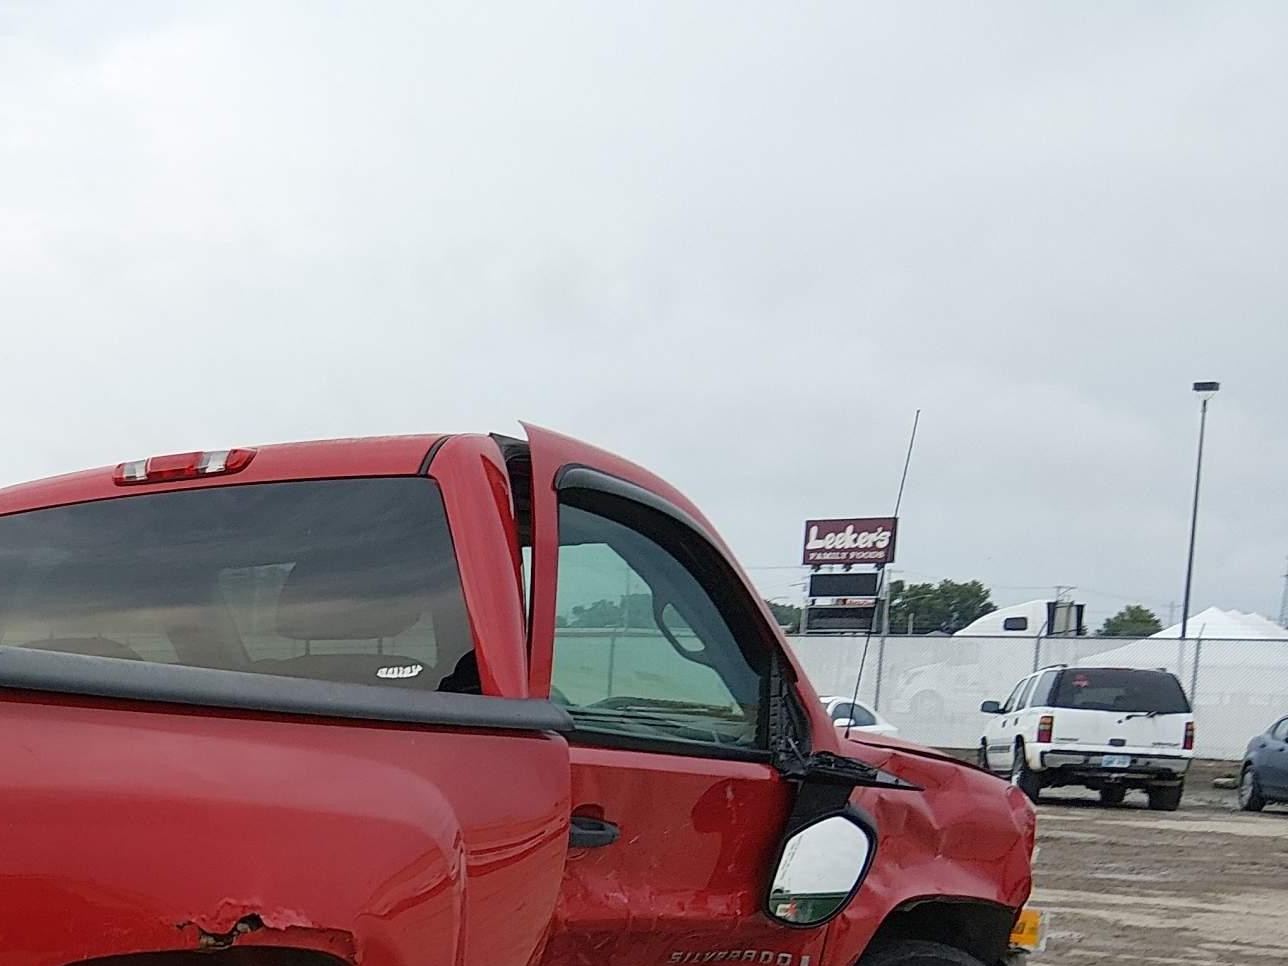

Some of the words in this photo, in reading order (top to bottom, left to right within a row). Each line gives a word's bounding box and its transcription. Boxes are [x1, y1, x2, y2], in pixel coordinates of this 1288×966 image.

[806, 524, 891, 550] Leeker's
[808, 551, 848, 560] FAMILY
[849, 550, 885, 559] FOODS
[667, 950, 792, 966] SILVERADO
